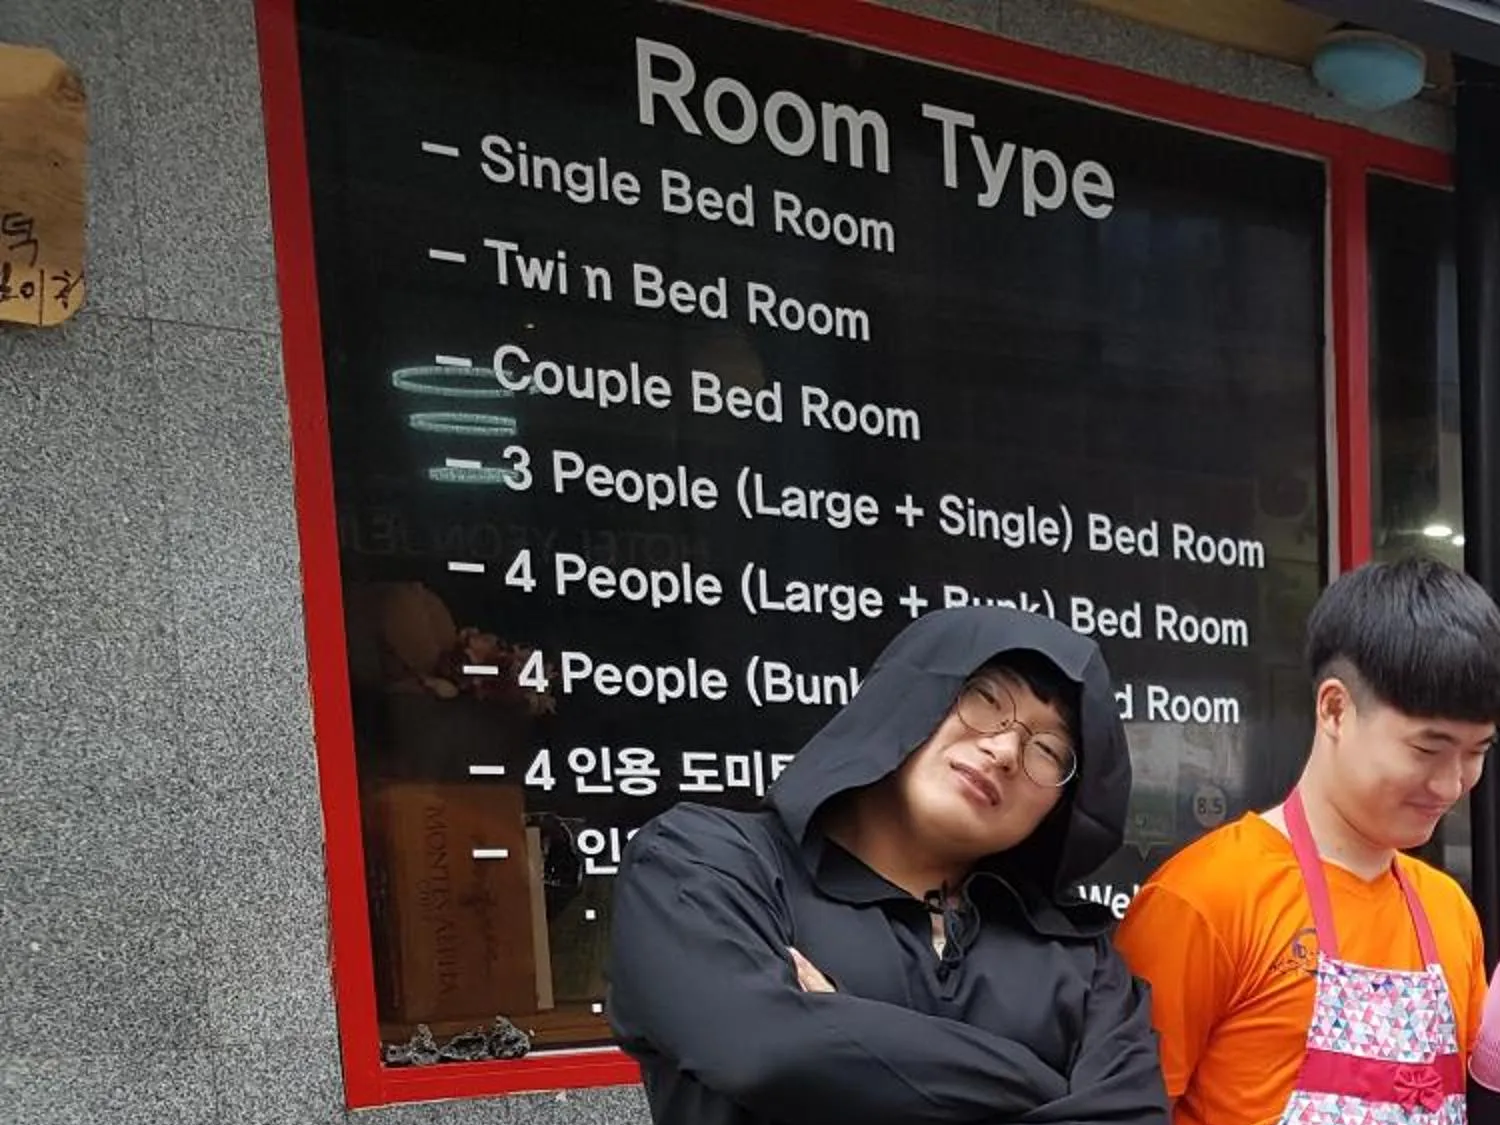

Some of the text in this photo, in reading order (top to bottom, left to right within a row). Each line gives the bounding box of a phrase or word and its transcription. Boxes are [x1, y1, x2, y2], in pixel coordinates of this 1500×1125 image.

[637, 38, 1115, 219] Room Type
[481, 136, 640, 205] Single
[661, 170, 754, 227] Bed
[773, 191, 895, 253] Room
[634, 264, 728, 319] Bed
[748, 282, 870, 341] Room
[493, 345, 672, 409] Couple
[692, 371, 783, 423] Bed
[802, 386, 921, 441] Room
[503, 446, 533, 491] 3
[553, 450, 719, 511] People
[738, 467, 879, 529] (Large
[939, 495, 1073, 553] Single)
[1088, 513, 1159, 558] Bed
[1173, 524, 1265, 569] Room
[505, 549, 537, 593] 4
[555, 553, 723, 609] People
[742, 563, 883, 622] (Large
[1071, 597, 1142, 639] Bed
[1156, 604, 1249, 647] Room
[518, 650, 549, 693] 4
[561, 652, 729, 704] People
[1147, 685, 1240, 724] Room
[525, 749, 556, 791] 4
[567, 747, 661, 797] 인용
